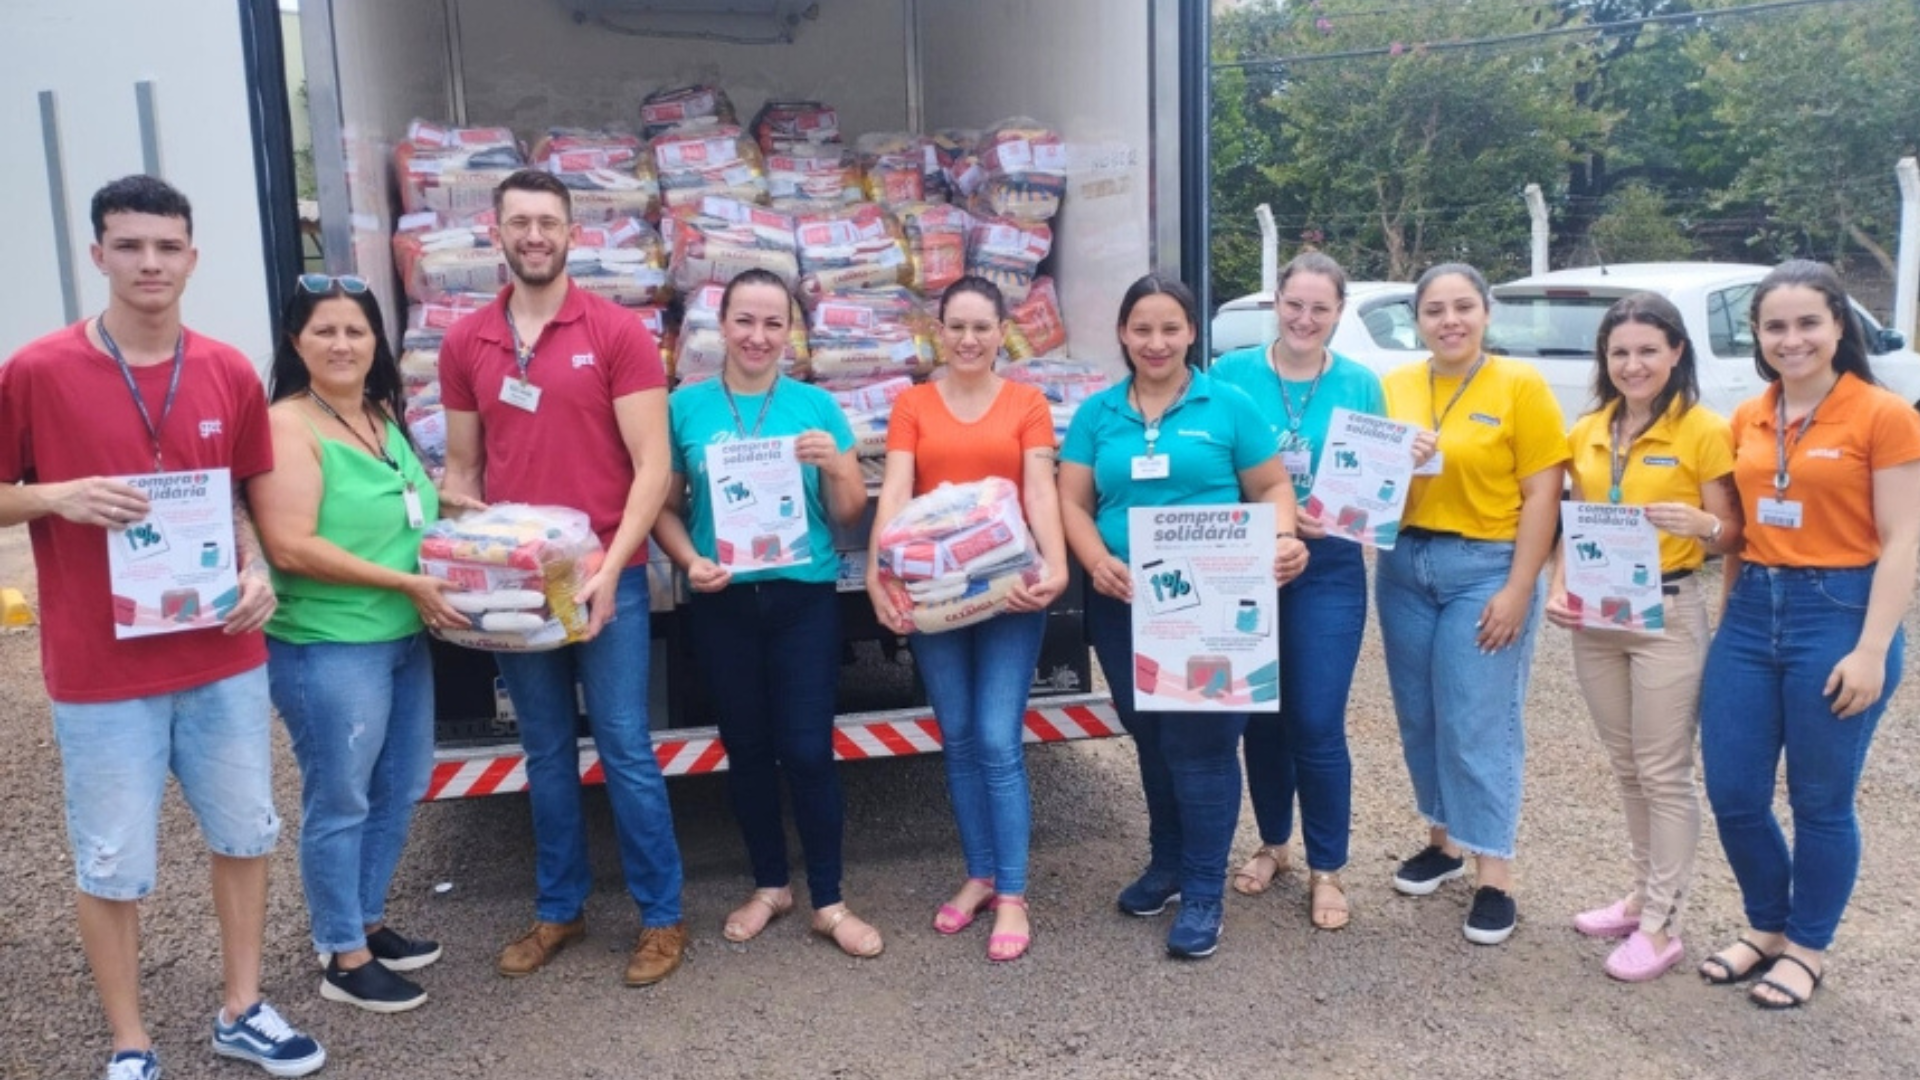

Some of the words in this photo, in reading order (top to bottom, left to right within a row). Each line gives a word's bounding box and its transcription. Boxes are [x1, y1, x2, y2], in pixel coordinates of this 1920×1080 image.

[1348, 414, 1396, 431] compra
[1334, 451, 1358, 468] 1%
[1154, 511, 1231, 526] compra
[1578, 505, 1627, 515] compra
[125, 523, 162, 551] 1%
[1153, 525, 1247, 542] solidária
[1576, 541, 1603, 561] 1%
[1150, 570, 1191, 602] 1%
